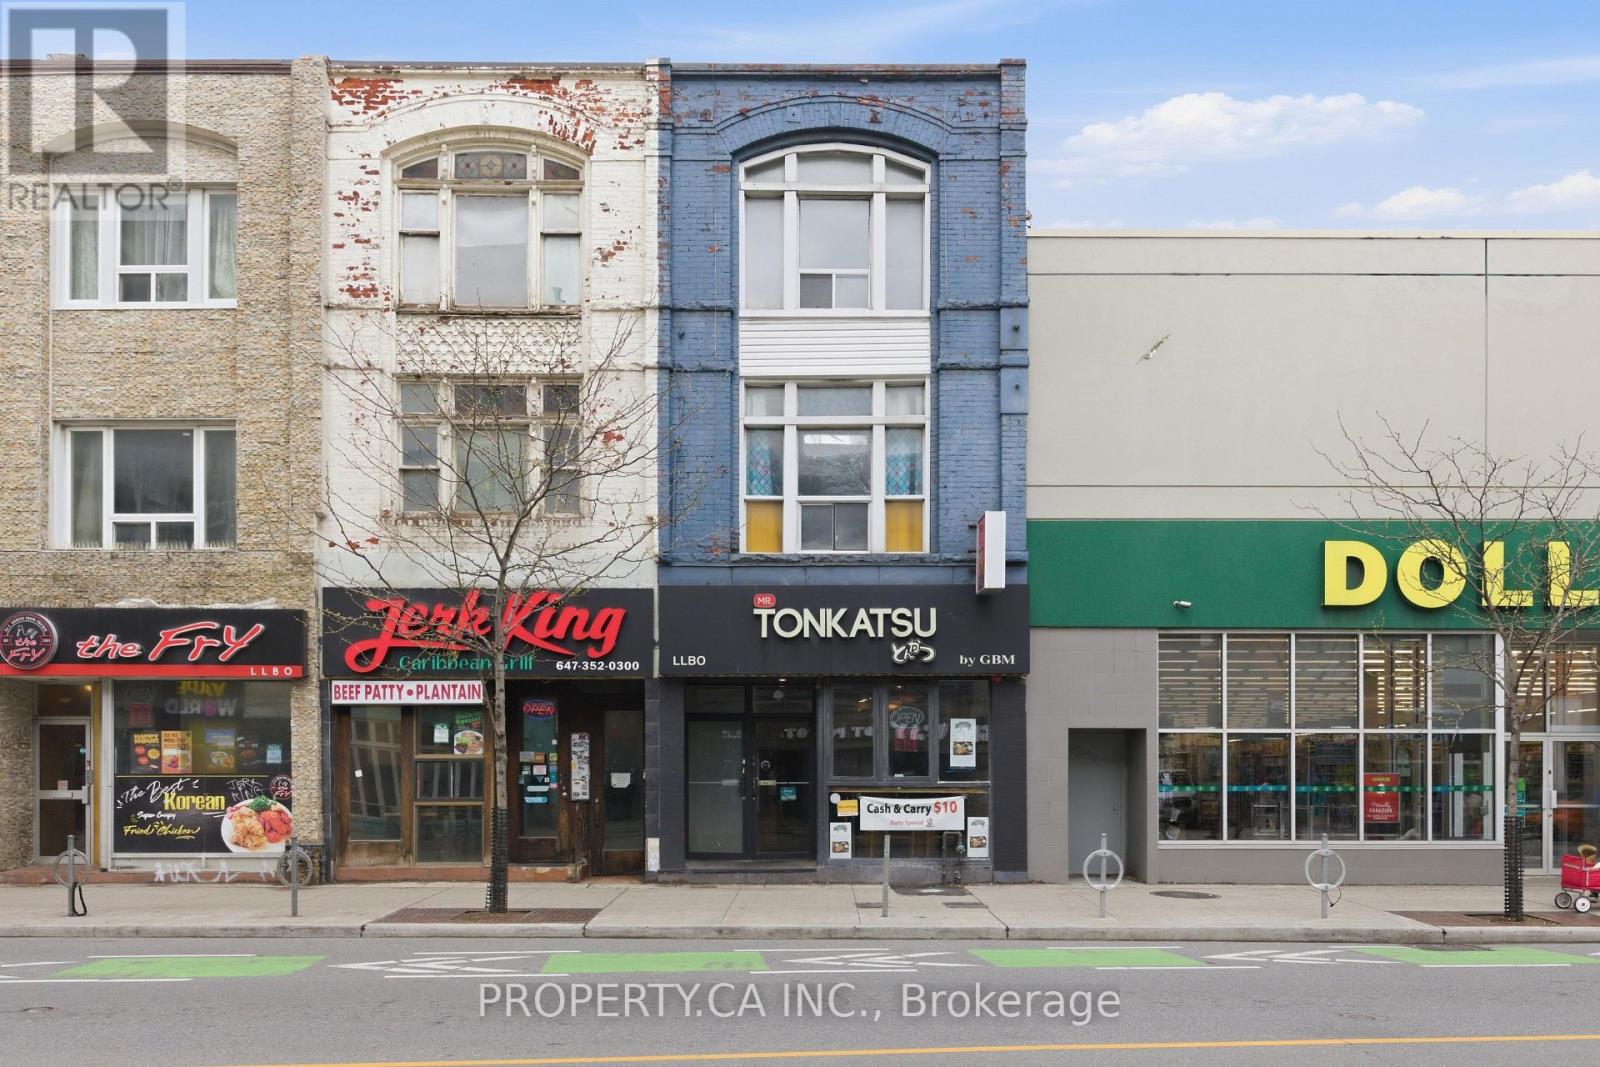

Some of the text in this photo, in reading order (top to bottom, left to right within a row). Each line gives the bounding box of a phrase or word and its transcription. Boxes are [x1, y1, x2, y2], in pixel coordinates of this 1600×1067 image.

[1323, 540, 1599, 608] DOLL
[753, 608, 937, 638] TONKATSU
[344, 589, 626, 673] Jerk King
[77, 634, 141, 660] the
[399, 655, 492, 670] Caribbean
[556, 661, 640, 672] 647-352-0300
[672, 655, 707, 666] LLBO
[959, 654, 1015, 667] by GBM
[334, 683, 481, 700] BEEF PATTY PLANTAIN
[523, 704, 555, 715] OPEN
[891, 712, 921, 724] OPEN
[121, 778, 191, 803] The Best
[164, 793, 226, 811] Korean
[867, 801, 957, 816] Cash & Carry $10
[123, 823, 200, 836] Fried Chicken
